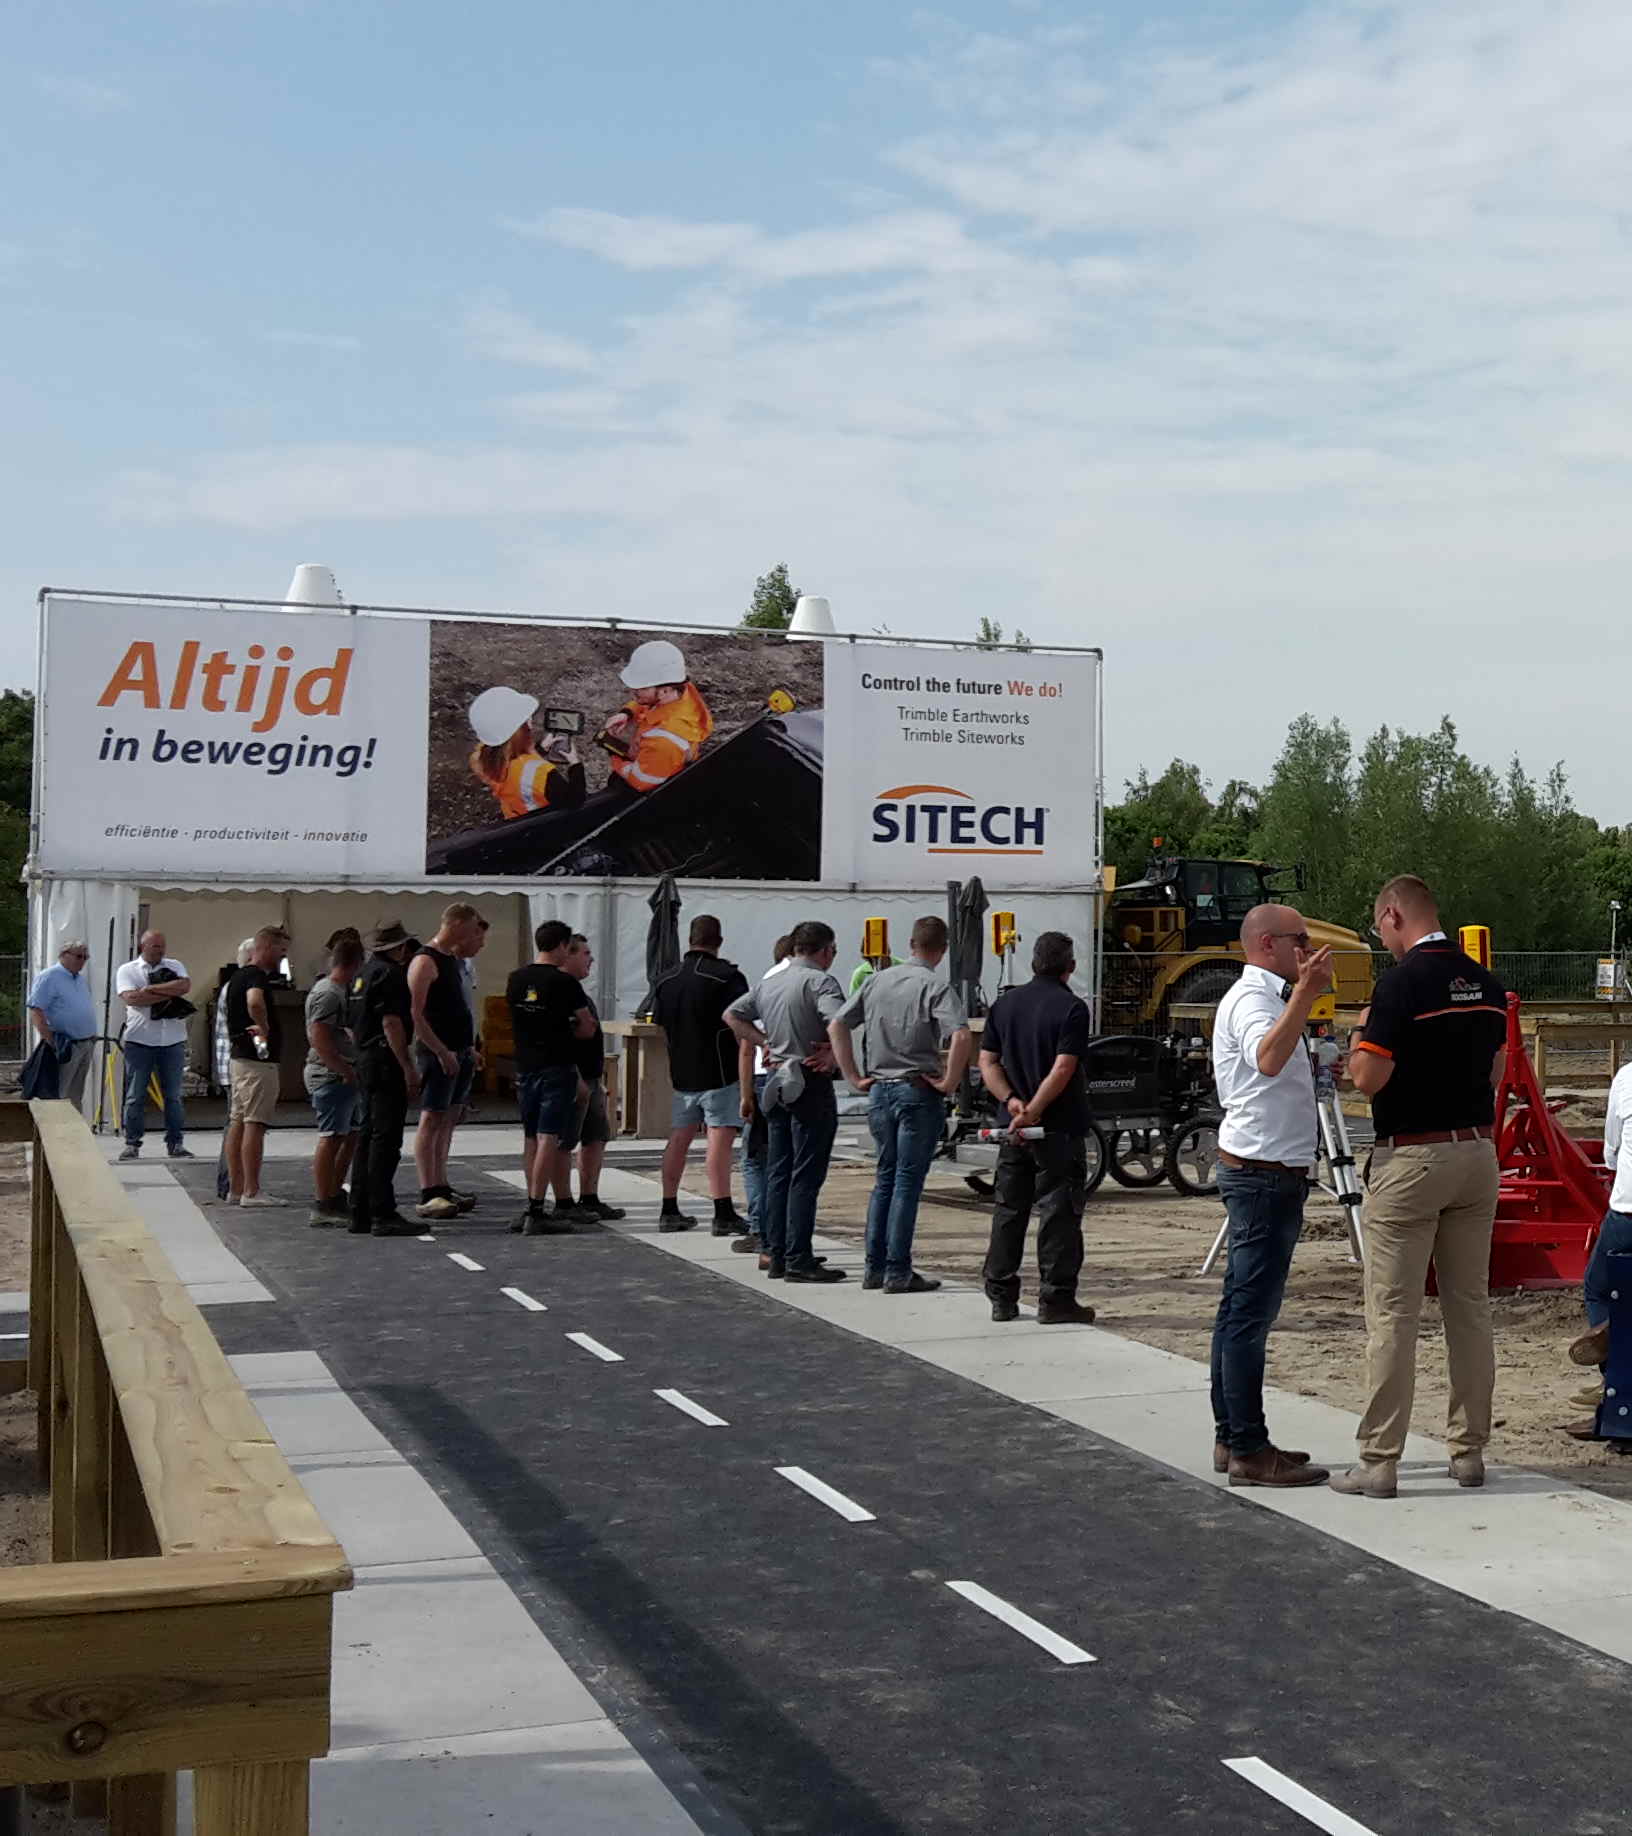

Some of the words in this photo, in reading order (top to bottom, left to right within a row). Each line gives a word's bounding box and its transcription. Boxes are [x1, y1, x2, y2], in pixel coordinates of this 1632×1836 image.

[97, 641, 353, 733] Altijd
[861, 673, 920, 692] Control
[926, 677, 951, 694] the
[956, 678, 1002, 696] future
[1007, 680, 1034, 697] We
[1039, 682, 1062, 698] do!
[897, 706, 947, 722] Trimble
[953, 709, 1030, 726] Earthworks
[902, 728, 953, 743] Trimble
[958, 730, 1025, 746] Siteworks
[99, 728, 140, 761] in
[152, 729, 377, 777] beweging!
[104, 824, 178, 839] efficiëntie
[193, 826, 290, 842] productiviteit
[303, 829, 368, 843] innovatie
[872, 803, 1044, 845] SITECH
